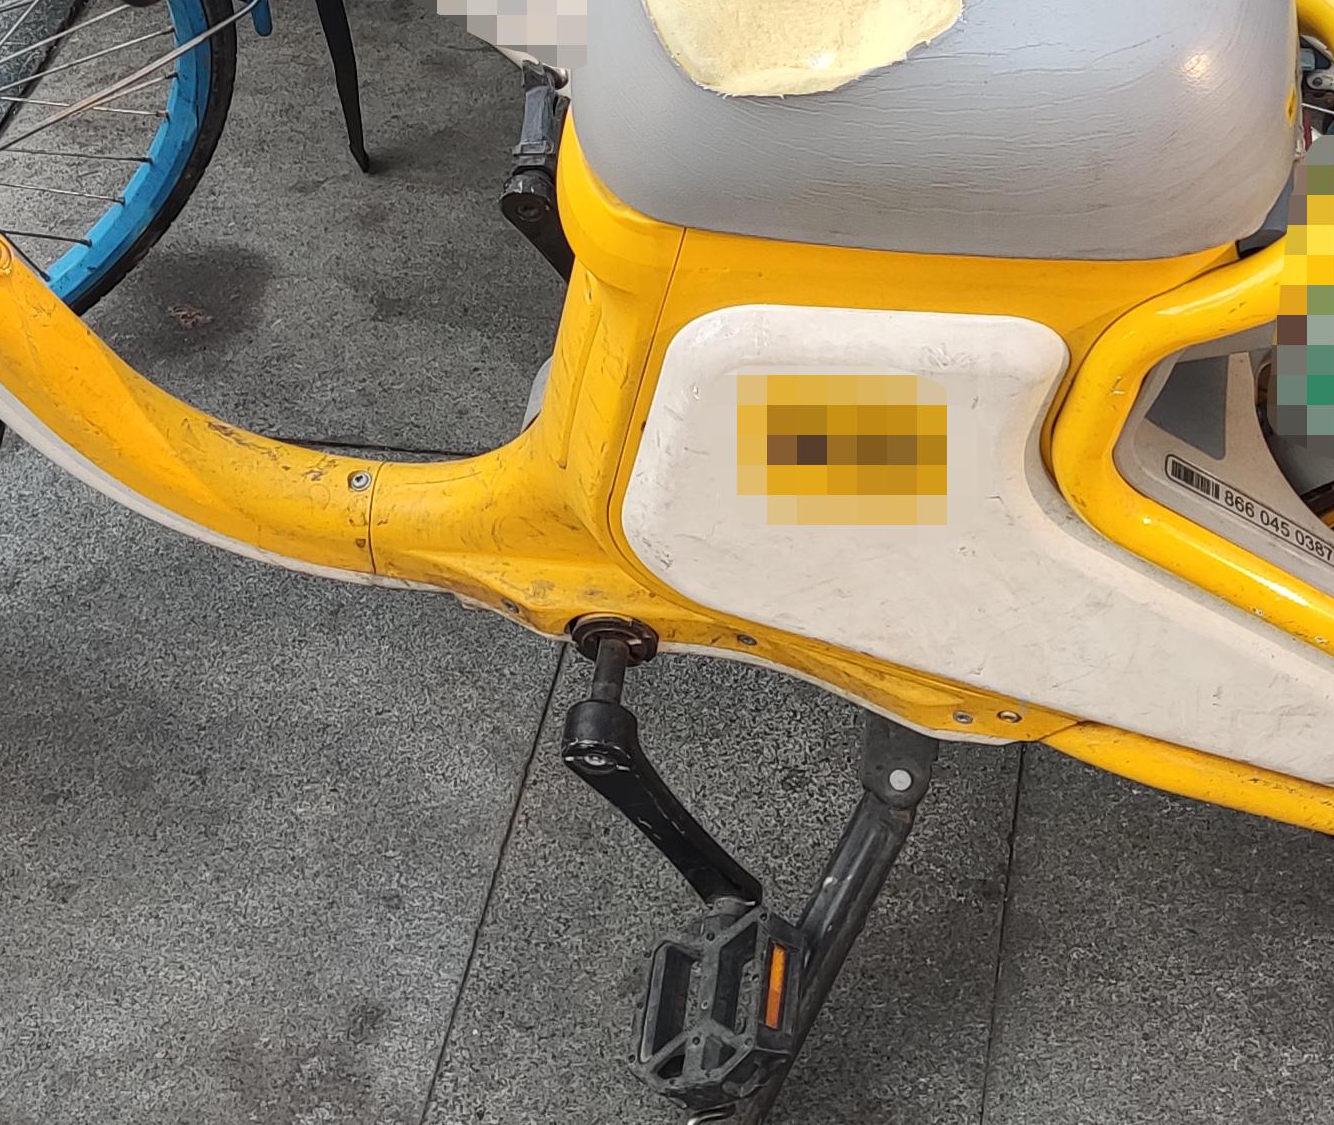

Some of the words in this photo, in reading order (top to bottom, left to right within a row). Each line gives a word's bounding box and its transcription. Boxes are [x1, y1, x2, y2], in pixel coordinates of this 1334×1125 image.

[1224, 489, 1255, 518] 866
[1260, 509, 1291, 538] 045
[1295, 529, 1334, 562] 0387
